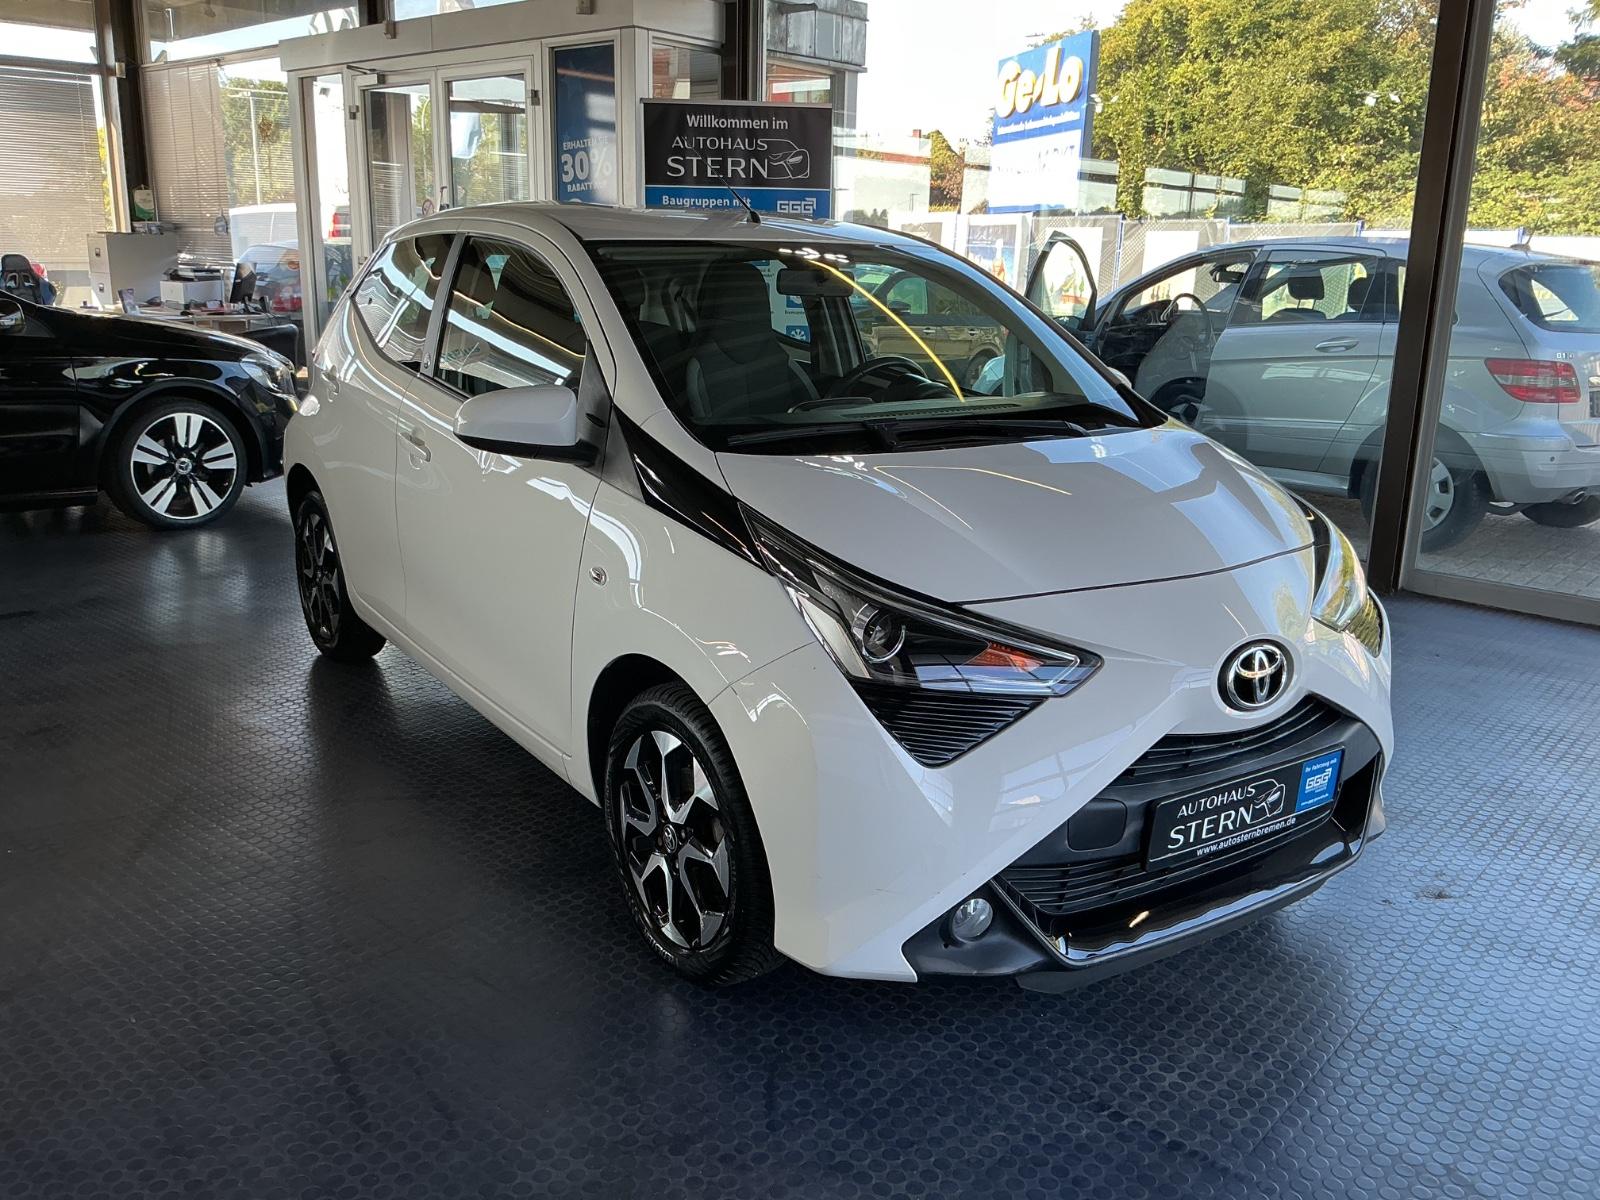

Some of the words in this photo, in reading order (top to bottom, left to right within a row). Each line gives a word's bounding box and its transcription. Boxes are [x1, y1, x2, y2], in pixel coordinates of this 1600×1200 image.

[686, 114, 768, 129] Willkommen
[772, 117, 788, 129] im
[672, 136, 768, 150] AUTOHAUS
[561, 147, 612, 183] 30%
[666, 156, 768, 178] STERN
[662, 195, 730, 208] Baugruppen
[776, 198, 816, 214] GGG
[1305, 767, 1332, 790] GGG
[1177, 785, 1256, 819] AUTOHAUS
[1168, 804, 1254, 849] STERN
[1196, 816, 1297, 857] www.autosternbremen.de
